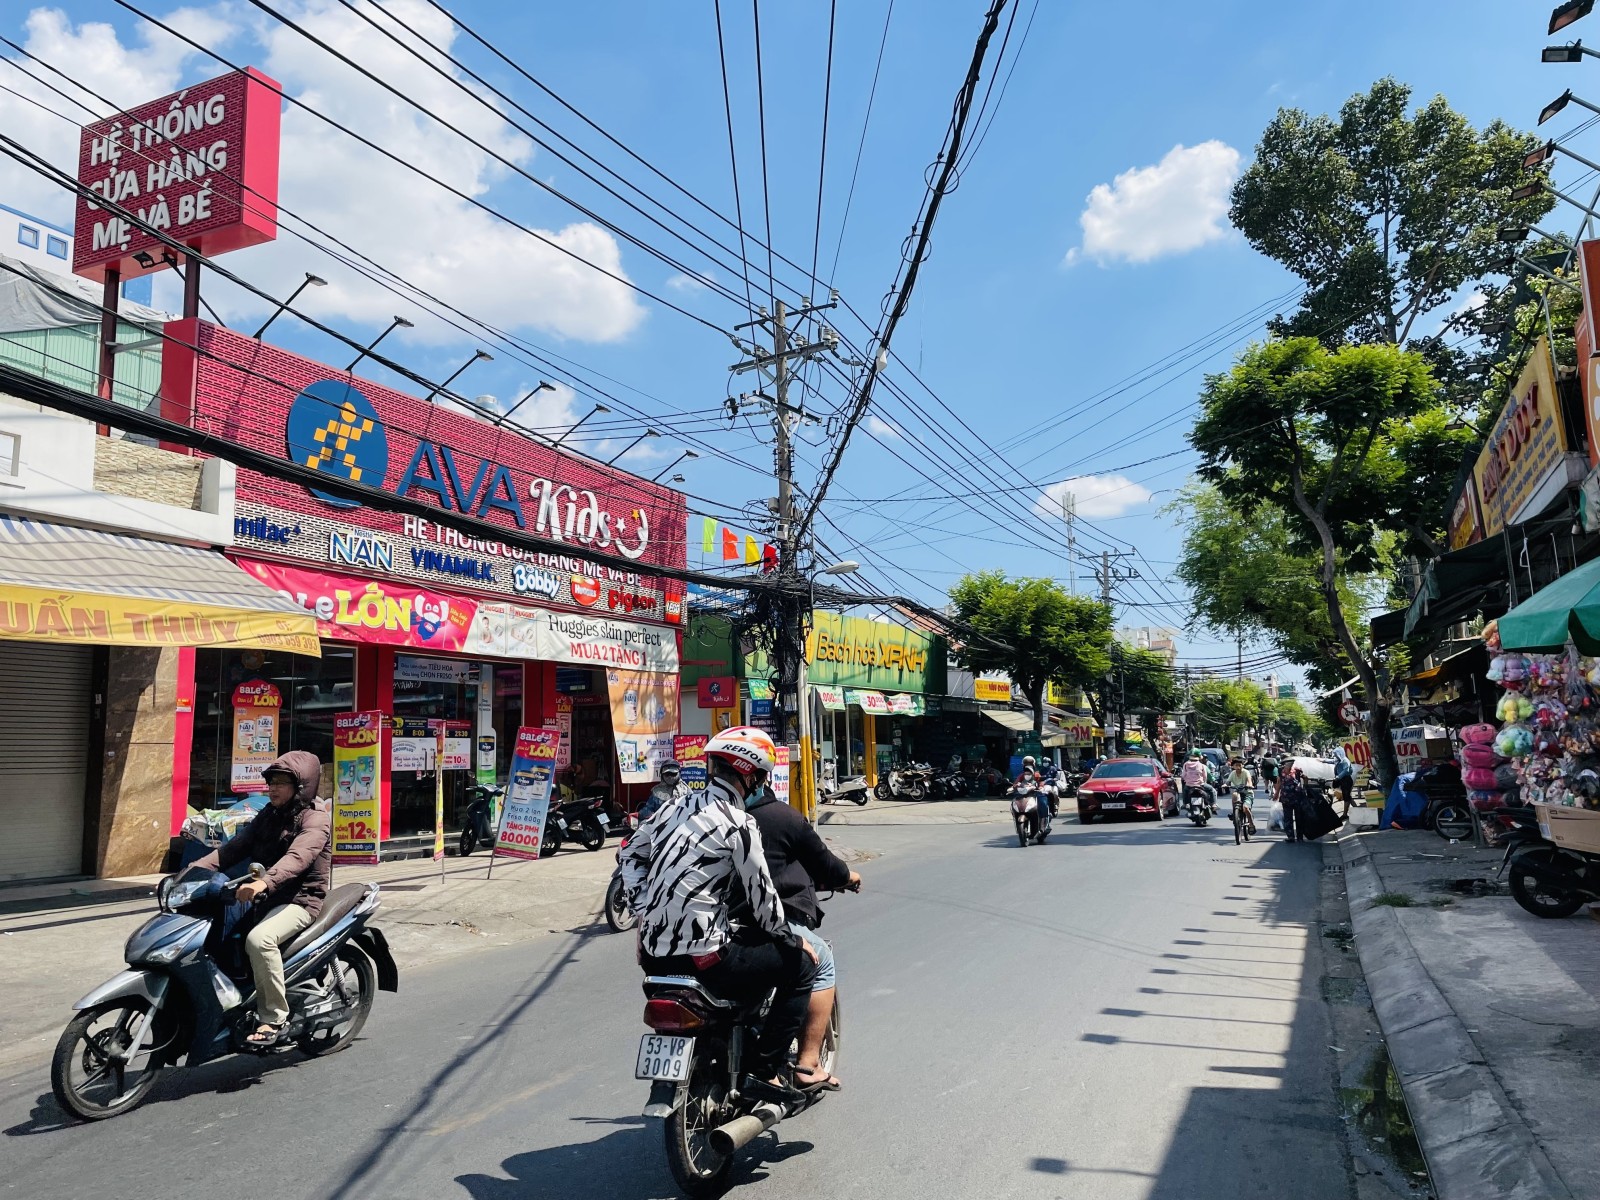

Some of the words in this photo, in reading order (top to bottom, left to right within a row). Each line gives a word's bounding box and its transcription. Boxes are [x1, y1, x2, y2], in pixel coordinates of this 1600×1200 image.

[91, 122, 123, 166] HỆ
[130, 90, 225, 151] THỐNG
[87, 167, 140, 210] CỬA
[147, 140, 228, 192] HÀNG
[92, 217, 131, 251] MẸ
[138, 194, 172, 235] VÀ
[178, 178, 213, 226] BÉ
[394, 441, 526, 528] AVA
[530, 478, 611, 548] Kids
[330, 530, 393, 571] NAN
[411, 547, 493, 582] VINAMILK
[513, 564, 561, 598] Bobby
[124, 611, 240, 644] THÙY
[548, 615, 598, 639] Huggies
[601, 622, 622, 640] skin
[624, 628, 662, 646] perfect
[570, 642, 600, 660] MUA
[603, 646, 608, 660] 2
[610, 645, 640, 667] TẶNG
[642, 652, 647, 666] 1
[721, 743, 763, 765] REPSOL
[339, 808, 372, 819] Pampers
[510, 804, 523, 812] Mua
[524, 814, 541, 824] 800g
[348, 821, 377, 840] 12%
[506, 820, 523, 832] TẶNG
[646, 1037, 686, 1056] 53-V8
[643, 1058, 682, 1078] 3009
